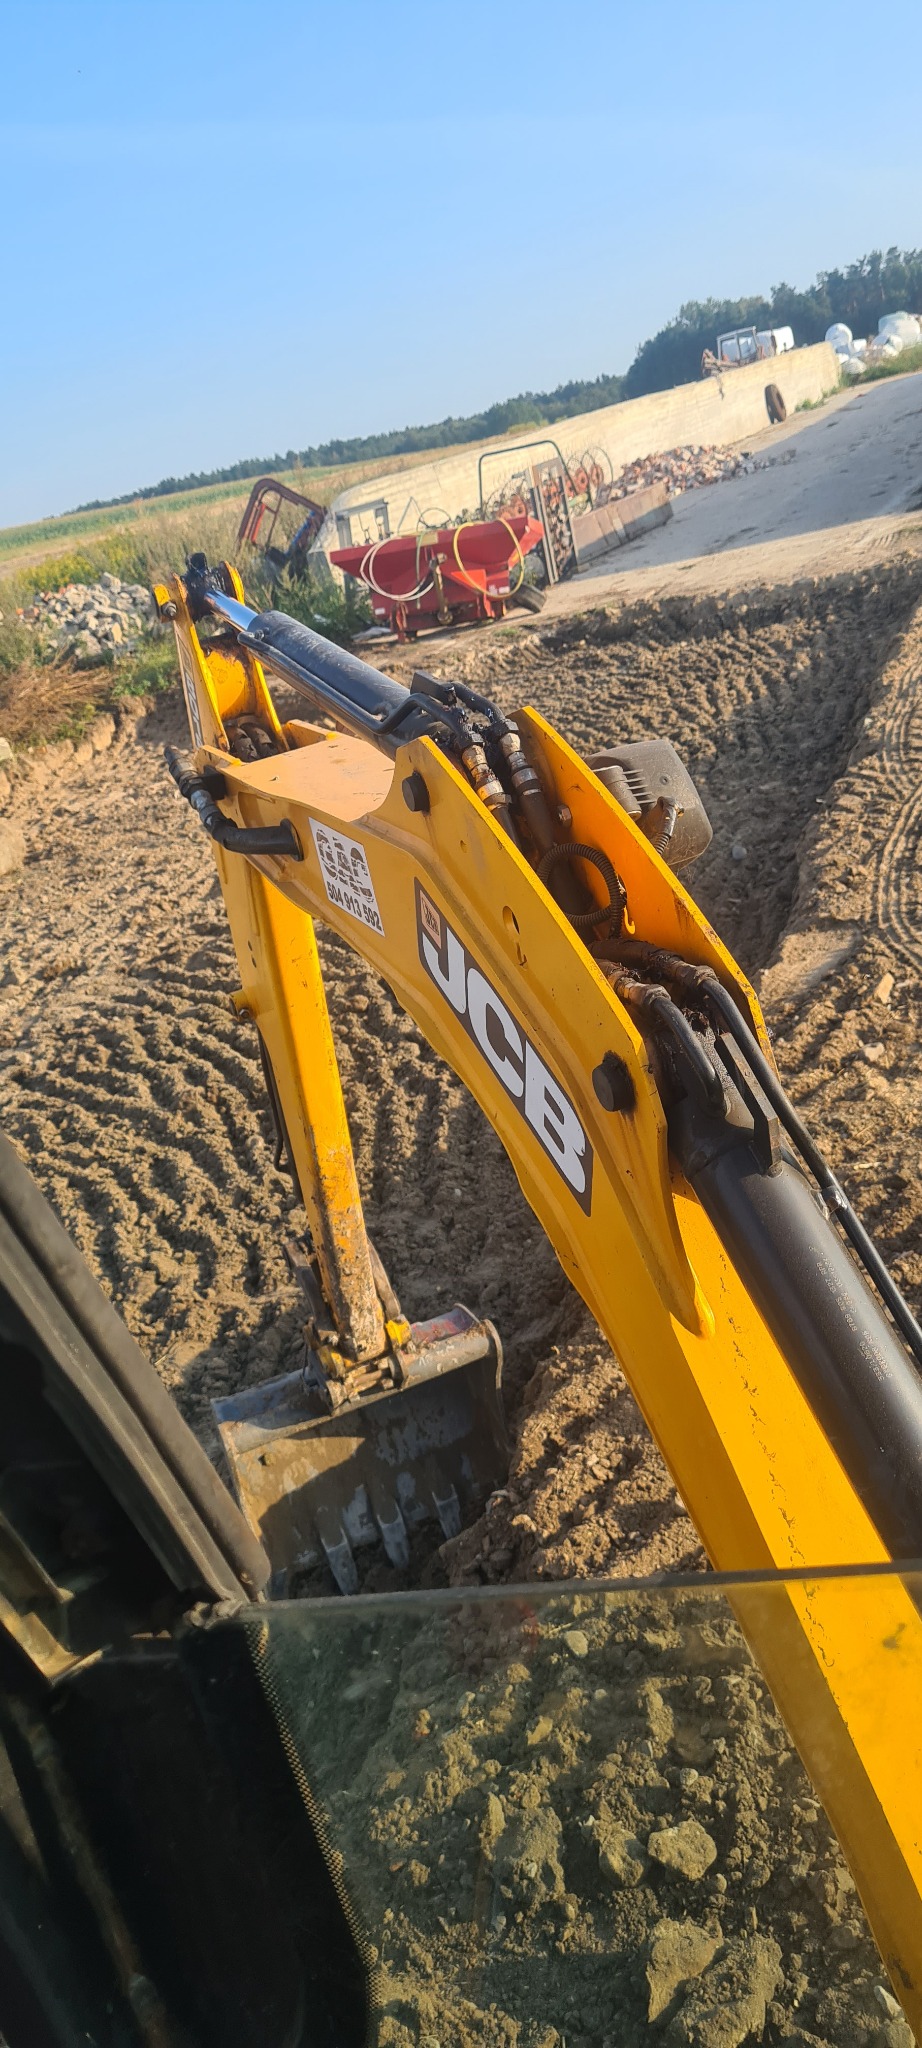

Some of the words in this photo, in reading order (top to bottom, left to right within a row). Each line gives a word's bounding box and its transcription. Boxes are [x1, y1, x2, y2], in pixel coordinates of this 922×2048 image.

[326, 881, 344, 906] 504
[344, 891, 362, 918] 913
[362, 904, 382, 932] 592
[422, 927, 586, 1194] JCB
